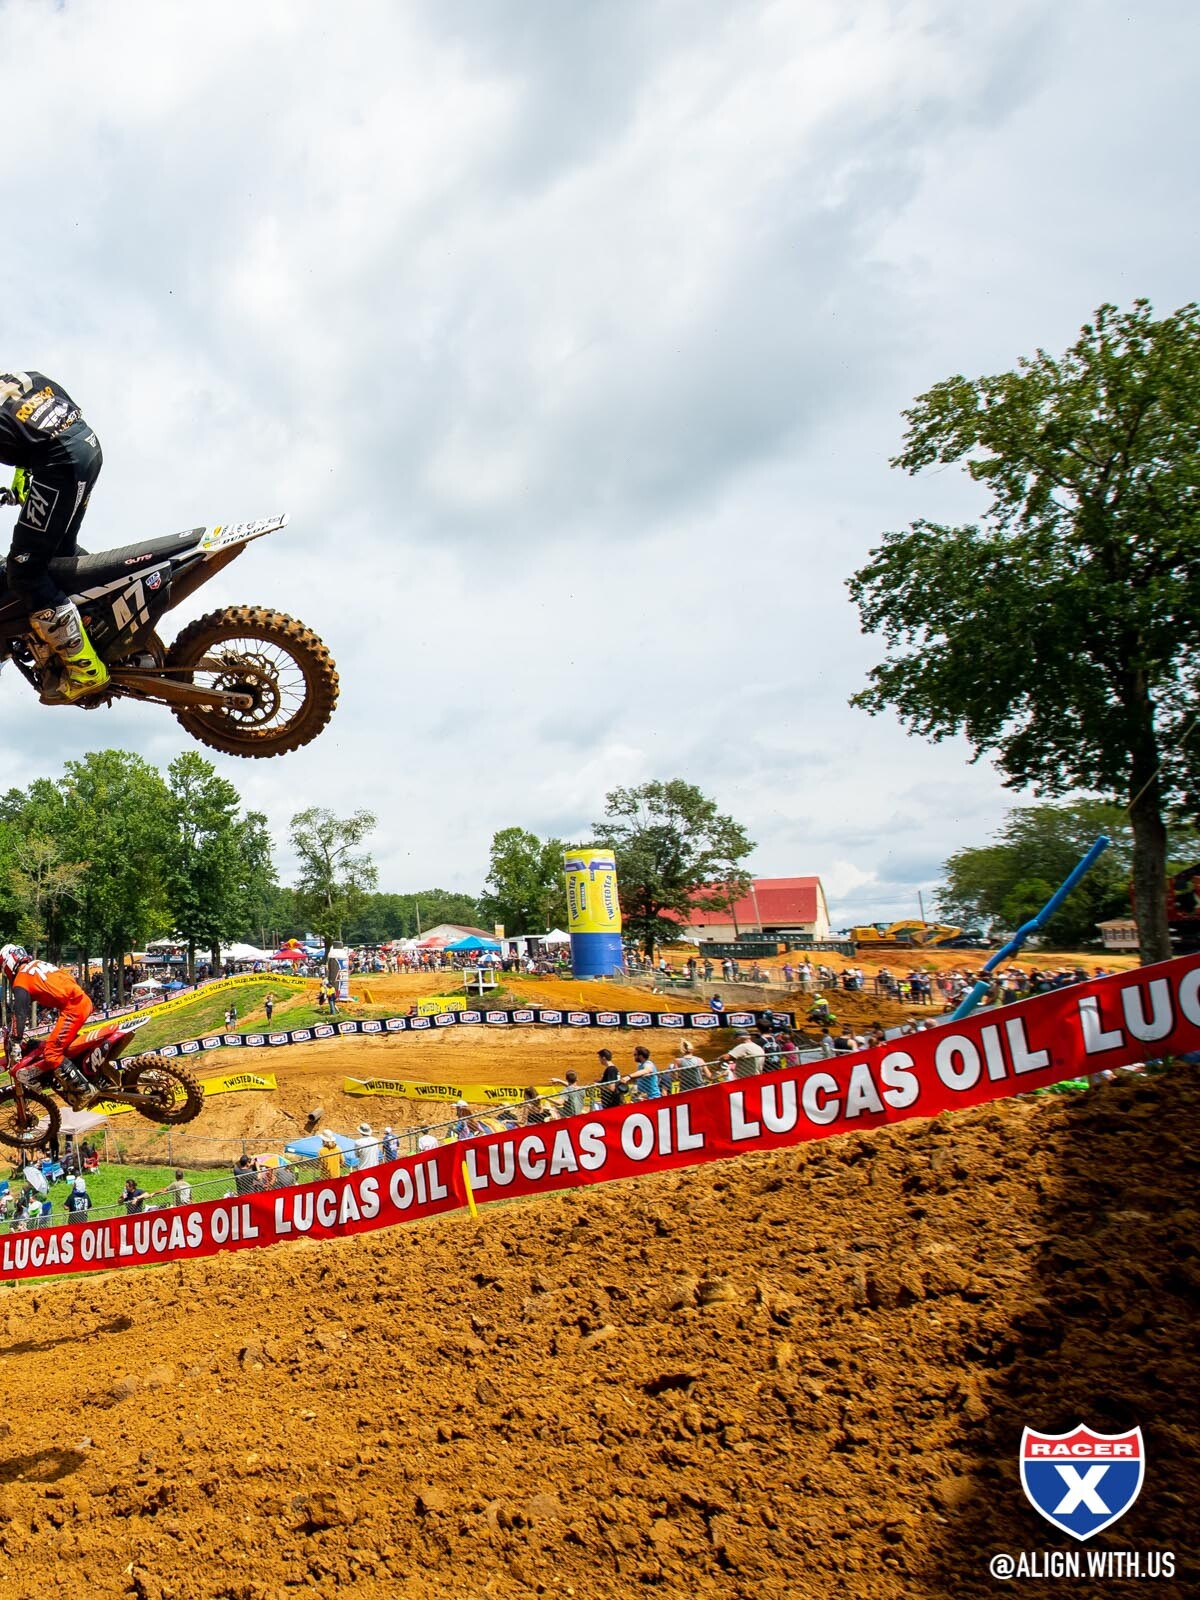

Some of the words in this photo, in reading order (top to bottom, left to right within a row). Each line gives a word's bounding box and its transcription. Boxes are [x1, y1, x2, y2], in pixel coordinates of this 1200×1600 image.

[27, 486, 49, 526] FLY
[112, 579, 150, 634] 47
[543, 1012, 560, 1023] 100%
[570, 1014, 589, 1024] 100%
[599, 1014, 618, 1024] 100%
[629, 1014, 650, 1025] 100%
[661, 1015, 682, 1025] 100%
[693, 1014, 717, 1025] 100%
[730, 1014, 754, 1025] 100%
[224, 1075, 251, 1089] TWISTED
[364, 1081, 394, 1091] TWISTED
[415, 1086, 447, 1095] TWISTED
[448, 1086, 462, 1097] TEA
[484, 1088, 518, 1099] TWISTED
[2, 1231, 74, 1271] LUCAS
[80, 1226, 115, 1261] OIL
[119, 1211, 203, 1256] LUCAS
[210, 1203, 259, 1244] OIL
[273, 1176, 381, 1235] LUCAS
[389, 1159, 448, 1210] OIL
[465, 1122, 606, 1192] LUCAS
[620, 1103, 705, 1161] OIL
[729, 1050, 920, 1142] LUCAS
[934, 1017, 1050, 1092] OIL
